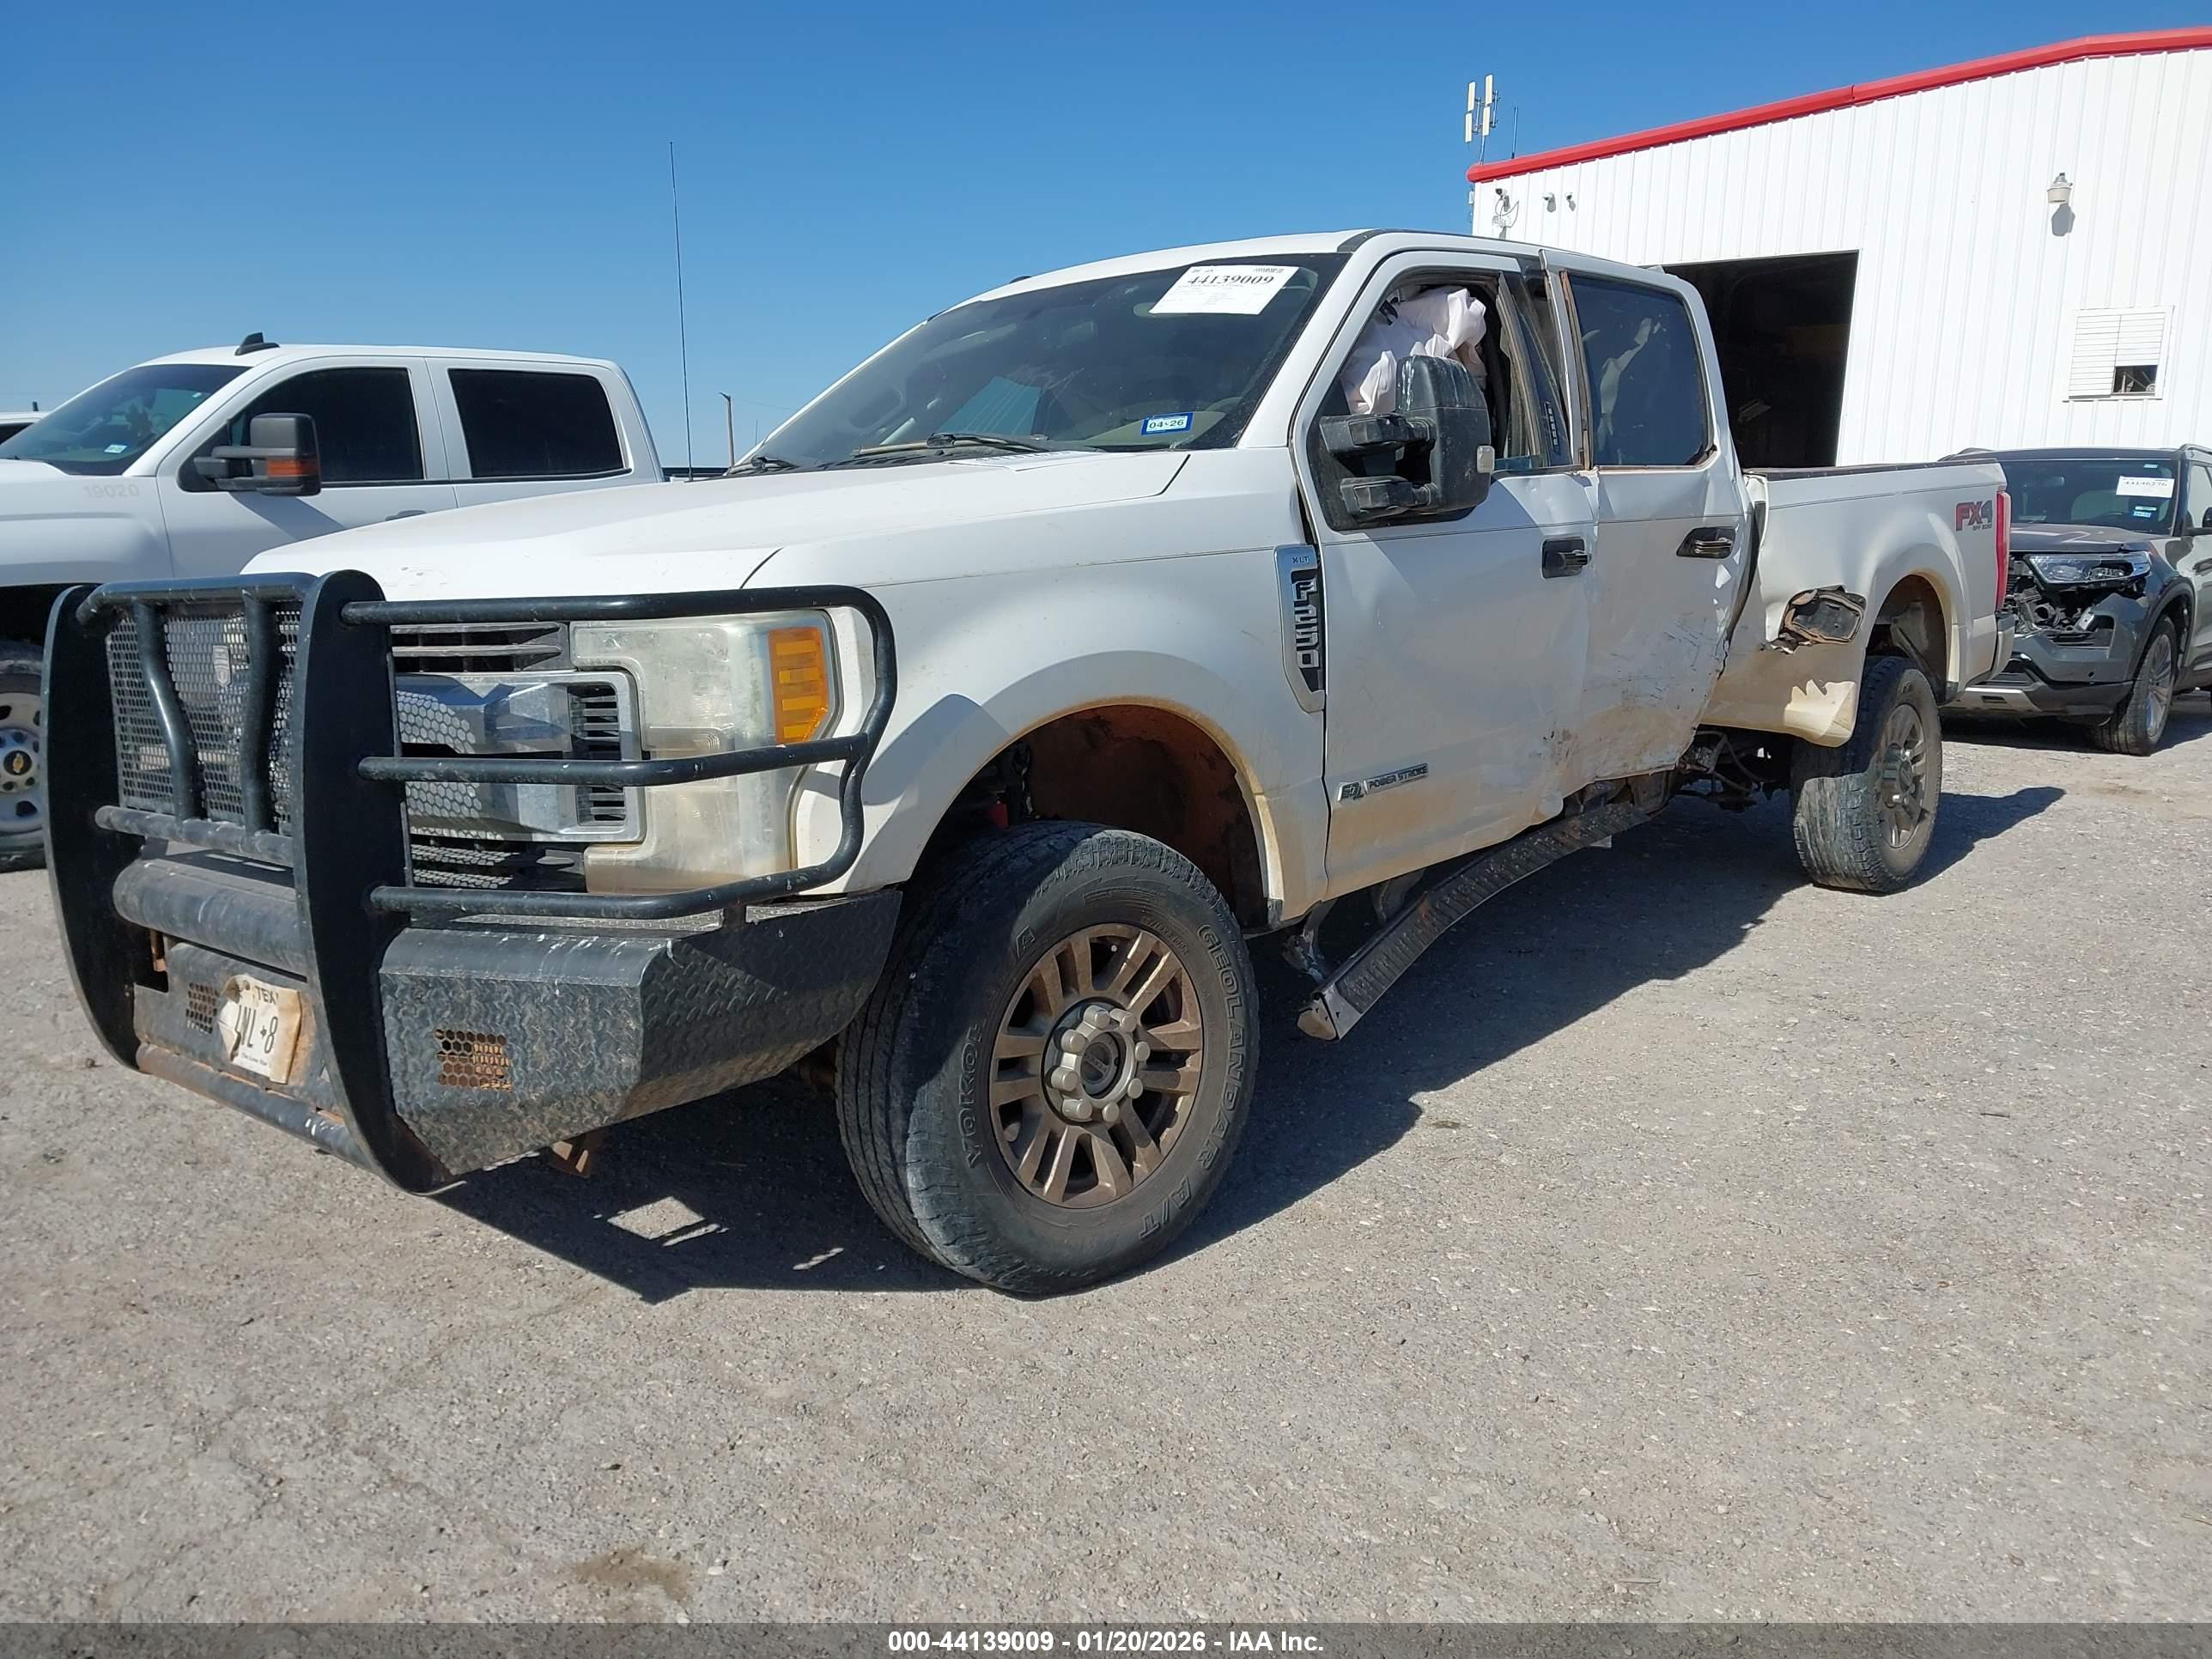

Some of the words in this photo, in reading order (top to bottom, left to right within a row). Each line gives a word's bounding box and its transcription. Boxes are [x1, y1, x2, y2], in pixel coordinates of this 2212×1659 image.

[1188, 275, 1274, 285] 44139009
[1955, 500, 1993, 532] FX4
[1291, 556, 1310, 564] XLT
[1369, 775, 1397, 789] POWER
[1397, 765, 1429, 781] STROKE
[957, 925, 1036, 1169] YOKOHA
[1197, 923, 1245, 1171] GEOLANDAR
[1139, 1173, 1192, 1242] A/T
